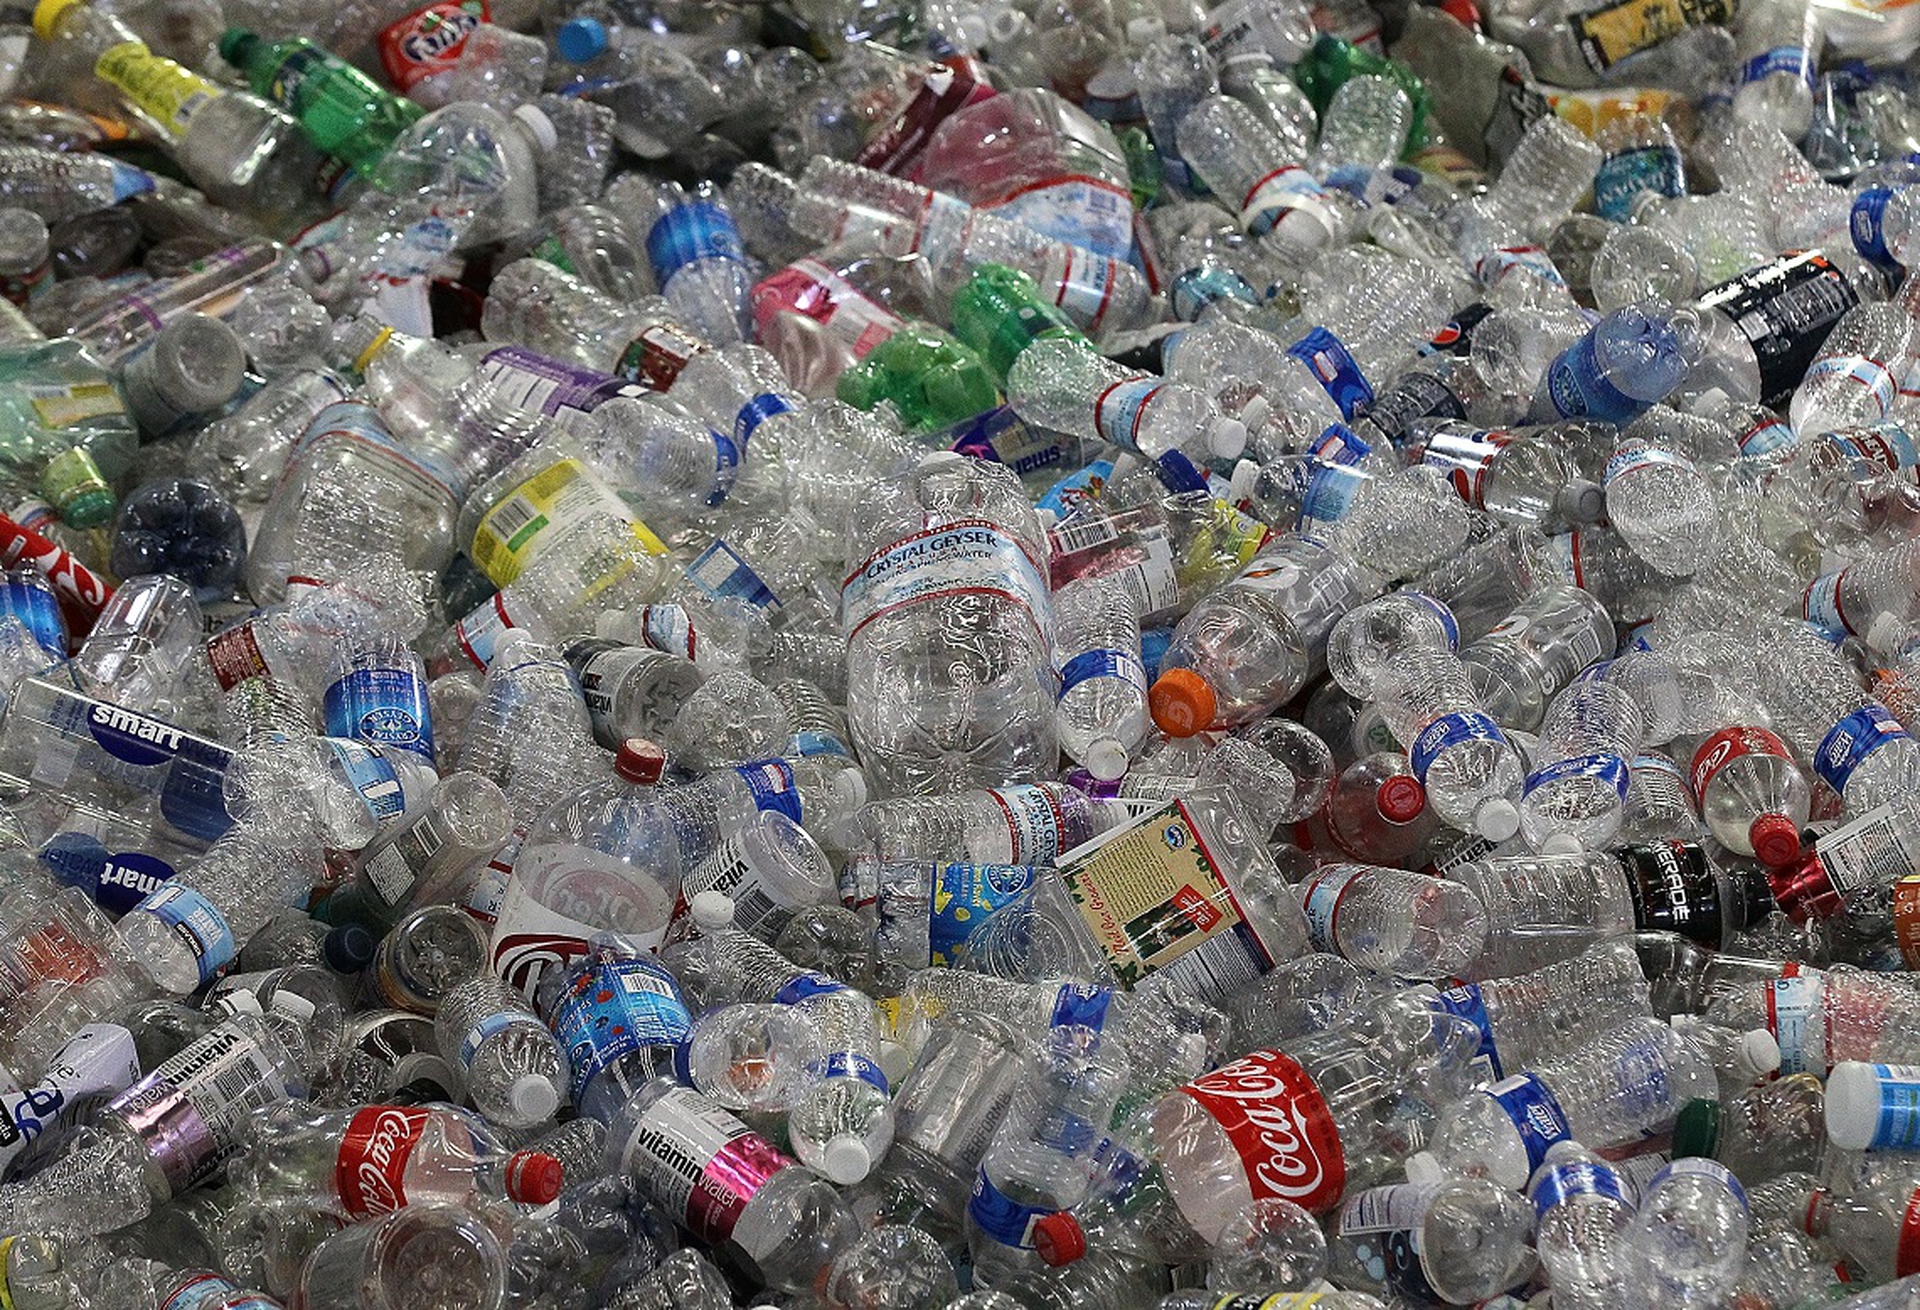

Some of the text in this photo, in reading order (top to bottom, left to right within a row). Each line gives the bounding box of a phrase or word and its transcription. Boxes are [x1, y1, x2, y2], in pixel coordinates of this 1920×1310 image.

[866, 531, 998, 580] CRYSTAL GEYSER
[92, 705, 184, 750] smart
[368, 710, 412, 723] GEYSER
[371, 728, 415, 741] CRYSTAL
[1043, 829, 1058, 869] GEYSE
[100, 861, 168, 895] mart
[1650, 841, 1690, 920] WERADE
[1527, 1102, 1560, 1141] Water
